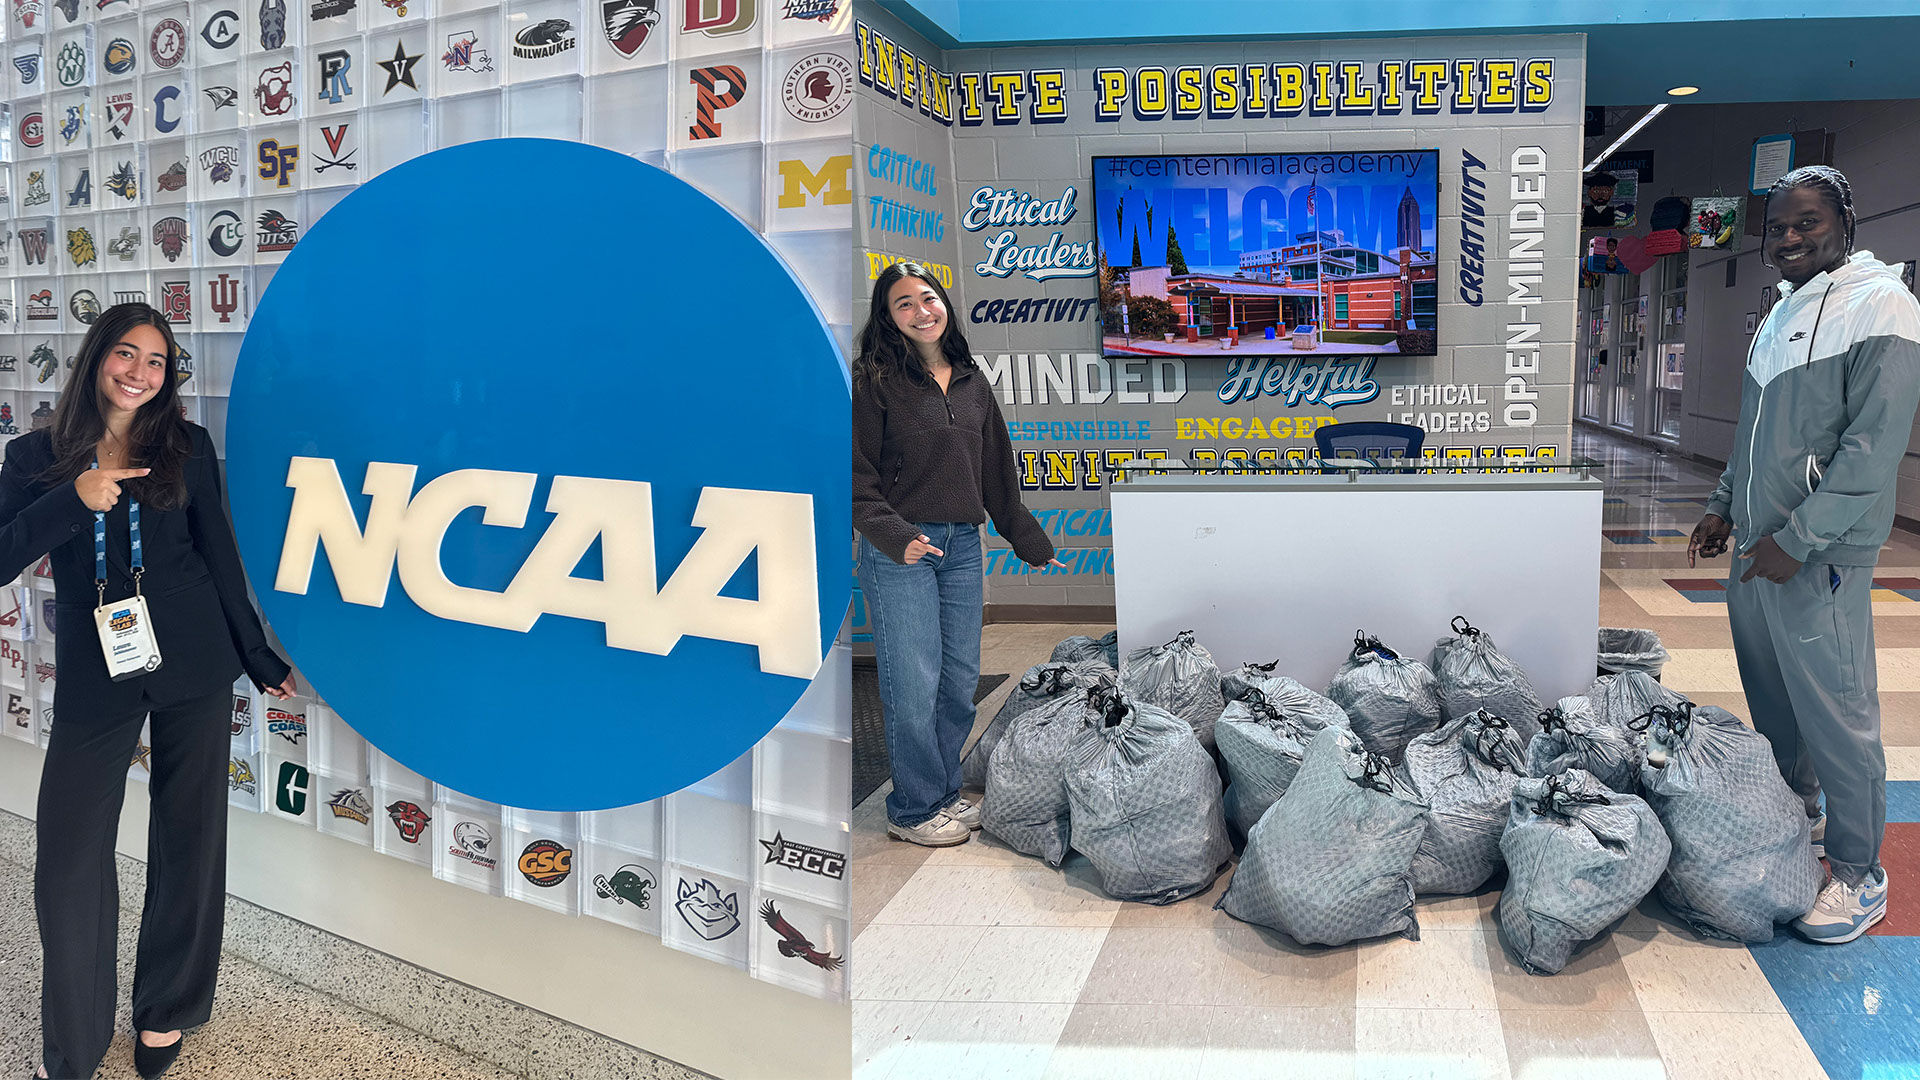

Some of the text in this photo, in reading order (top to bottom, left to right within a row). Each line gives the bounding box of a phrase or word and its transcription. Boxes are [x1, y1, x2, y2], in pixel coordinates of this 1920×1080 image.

[19, 4, 38, 14] STATE
[789, 1, 833, 17] PALTZ
[160, 33, 175, 54] A
[513, 37, 576, 59] MILWAUKEE
[63, 65, 77, 82] N
[392, 59, 408, 81] V
[786, 56, 852, 102] SOUTHERN VIRGINIA
[856, 18, 1555, 126] INFINITE POSSIBILITIES
[106, 92, 133, 103] LEWIS
[153, 85, 181, 133] C
[689, 65, 747, 140] P
[796, 103, 841, 119] KNIGHTS
[319, 123, 349, 158] V
[199, 146, 239, 170] WCU
[258, 138, 300, 188] SF
[868, 143, 937, 196] CRITICAL
[1108, 153, 1424, 178] #centennialacademy
[778, 155, 852, 209] M
[869, 196, 945, 243] THINKING
[962, 185, 1078, 232] Ethical
[153, 217, 188, 245] CWU
[260, 231, 298, 245] UTSA
[1459, 148, 1487, 307] CREATIVITY
[18, 227, 48, 265] W
[974, 230, 1098, 280] Leaders
[1503, 145, 1548, 427] OPEN-MINDED
[970, 298, 1100, 324] CREATIVIT
[1217, 357, 1382, 410] Helpful
[1392, 384, 1488, 406] ETHICAL
[1007, 420, 1150, 441] ESPONSIBLE
[274, 456, 822, 680] NCAA
[109, 613, 137, 627] LEGACY
[266, 712, 306, 723] COAST
[333, 804, 367, 824] MUSTANGS
[519, 850, 571, 874] GSC
[780, 847, 843, 878] ECC
[599, 879, 618, 899] TULANE
